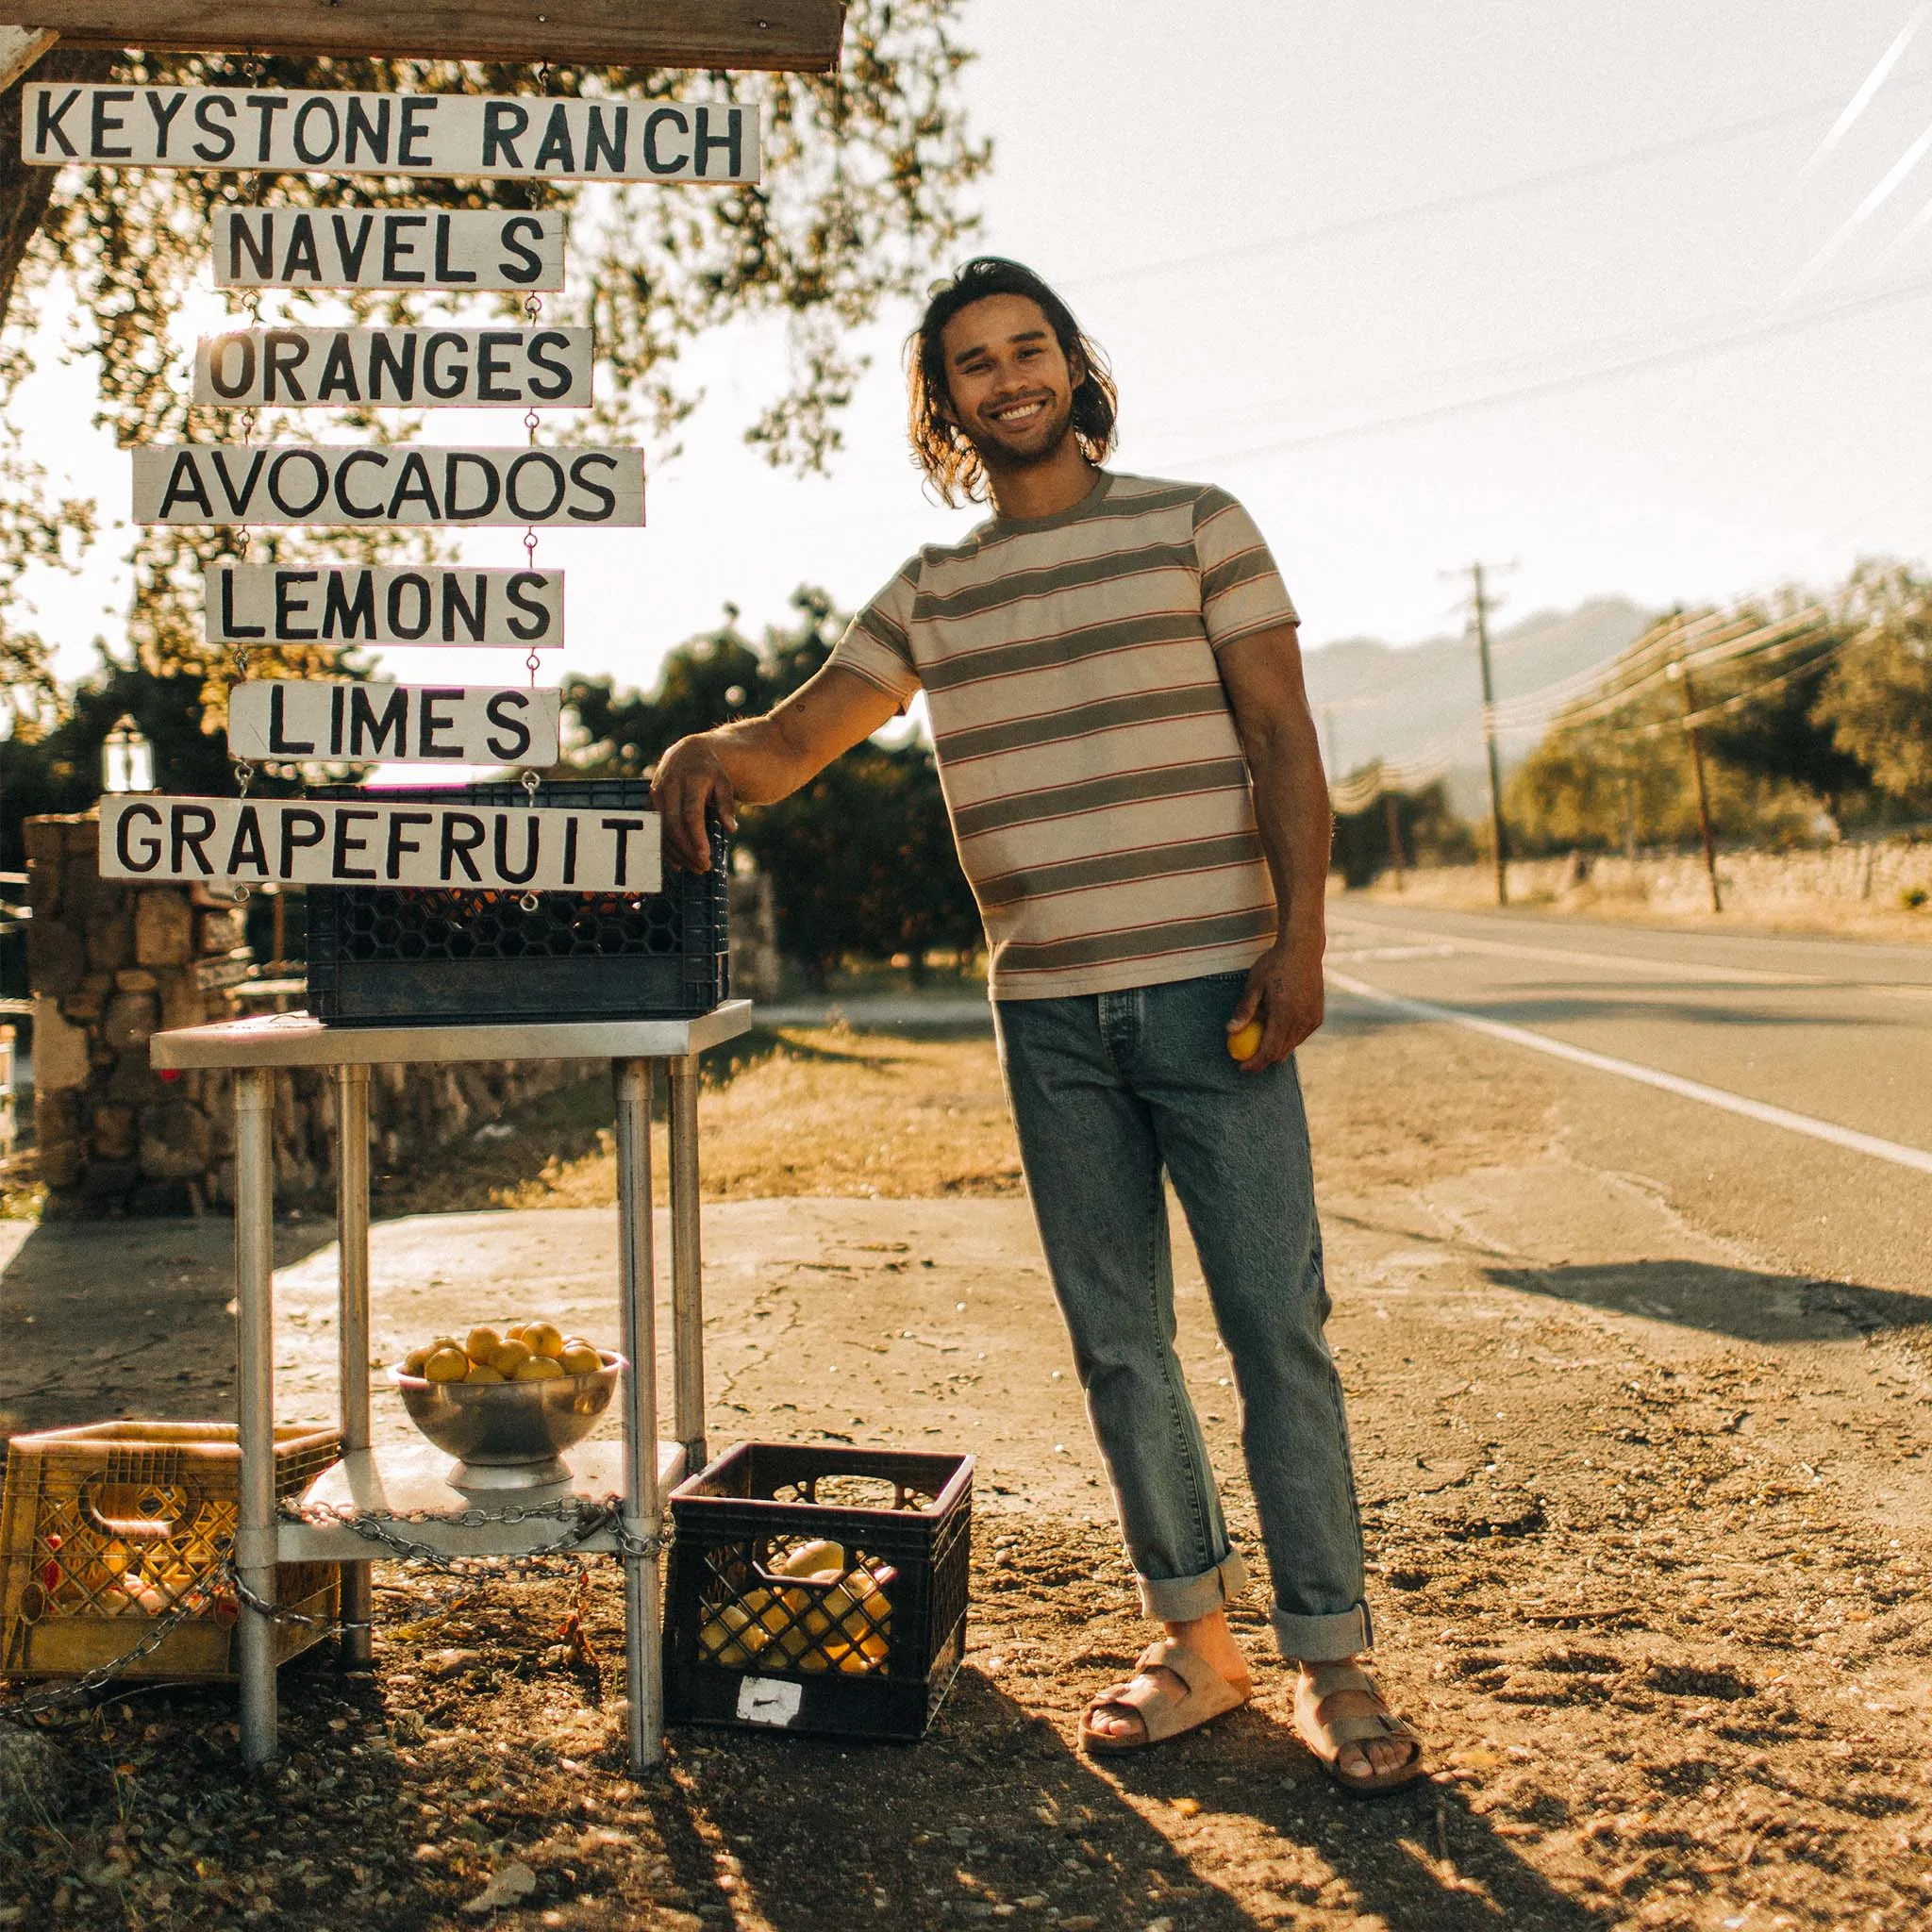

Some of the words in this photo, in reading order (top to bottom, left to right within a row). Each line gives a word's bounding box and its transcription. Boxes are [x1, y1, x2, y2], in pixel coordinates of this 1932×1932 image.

[35, 89, 440, 167] KEYSTONE
[482, 101, 743, 177] RANCH
[229, 212, 544, 284] NAVELS
[208, 331, 574, 402] ORANGES
[158, 449, 619, 522] AVOCADOS
[221, 568, 550, 642] LEMONS
[270, 684, 531, 759] LIMES
[115, 802, 645, 887] GRAPEFRUIT
